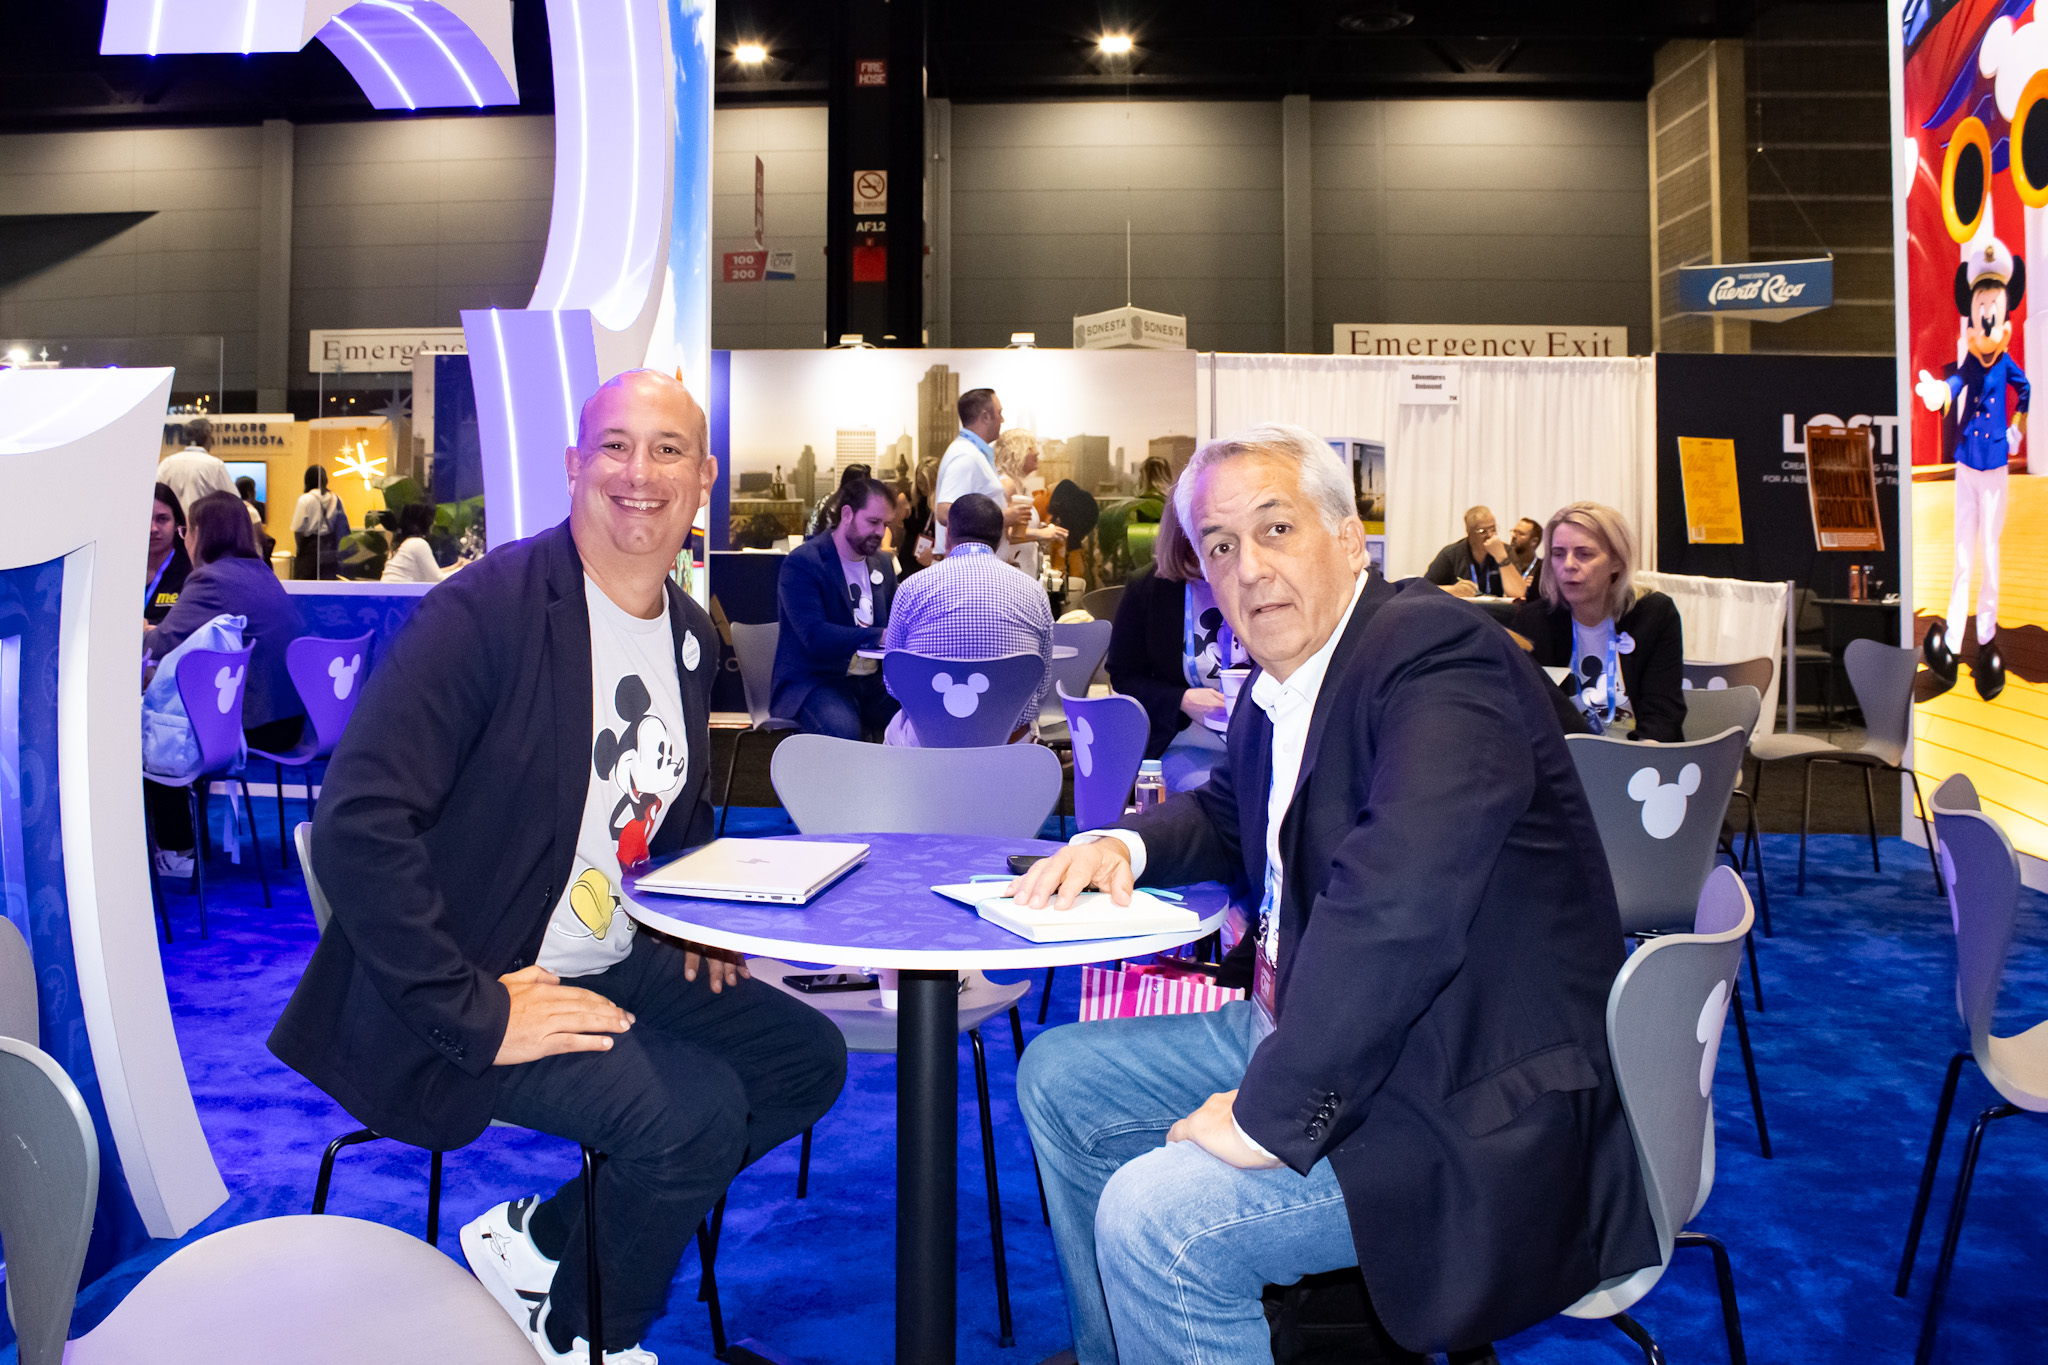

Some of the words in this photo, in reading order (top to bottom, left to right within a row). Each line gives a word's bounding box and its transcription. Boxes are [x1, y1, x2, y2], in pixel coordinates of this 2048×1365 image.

[861, 62, 883, 72] FIRE
[859, 74, 886, 84] HOSE
[856, 221, 886, 232] AF12
[733, 255, 754, 265] 100
[732, 269, 756, 279] 200
[1708, 276, 1763, 305] Puerto
[1761, 274, 1806, 303] Rico
[1086, 319, 1126, 336] SONESTA
[1144, 321, 1184, 337] SONESTA
[1547, 331, 1613, 357] Exit
